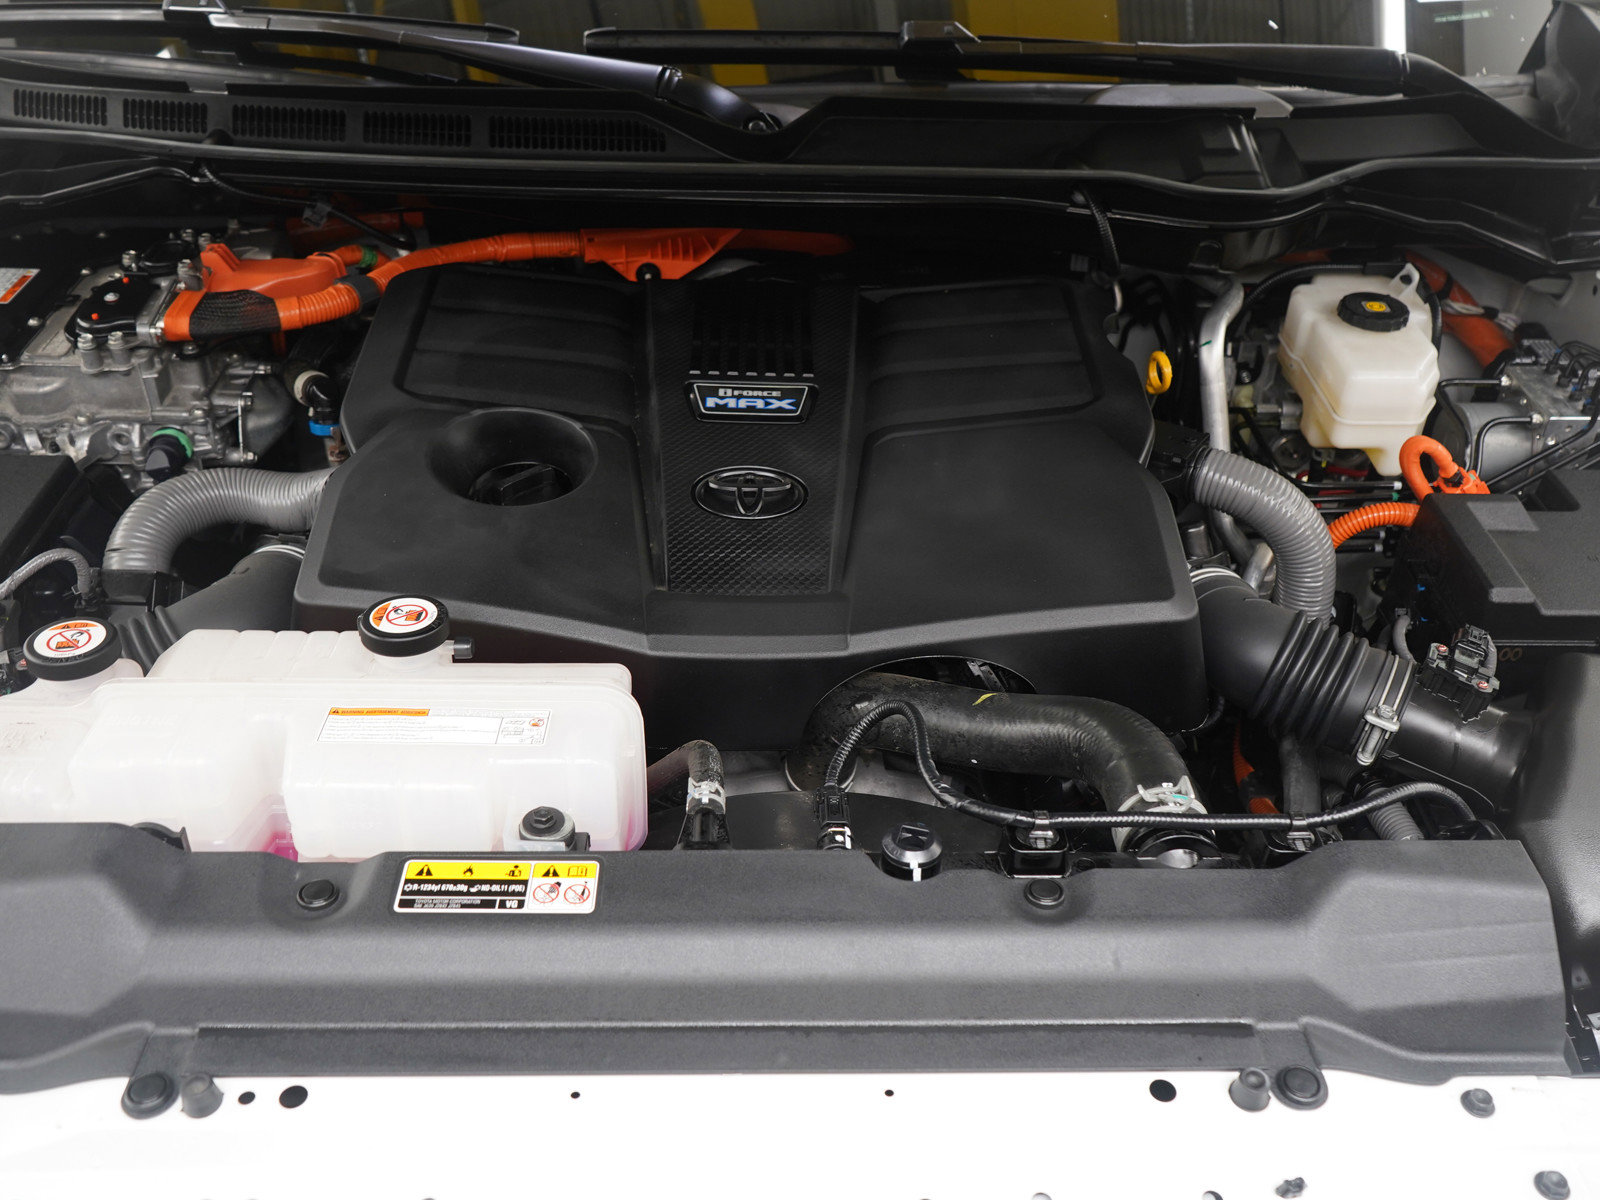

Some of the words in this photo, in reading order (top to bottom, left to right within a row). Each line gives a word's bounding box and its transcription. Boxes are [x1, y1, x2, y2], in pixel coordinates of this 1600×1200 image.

[705, 397, 797, 410] MAX
[412, 883, 440, 892] R-1234yf
[505, 900, 519, 909] VG
